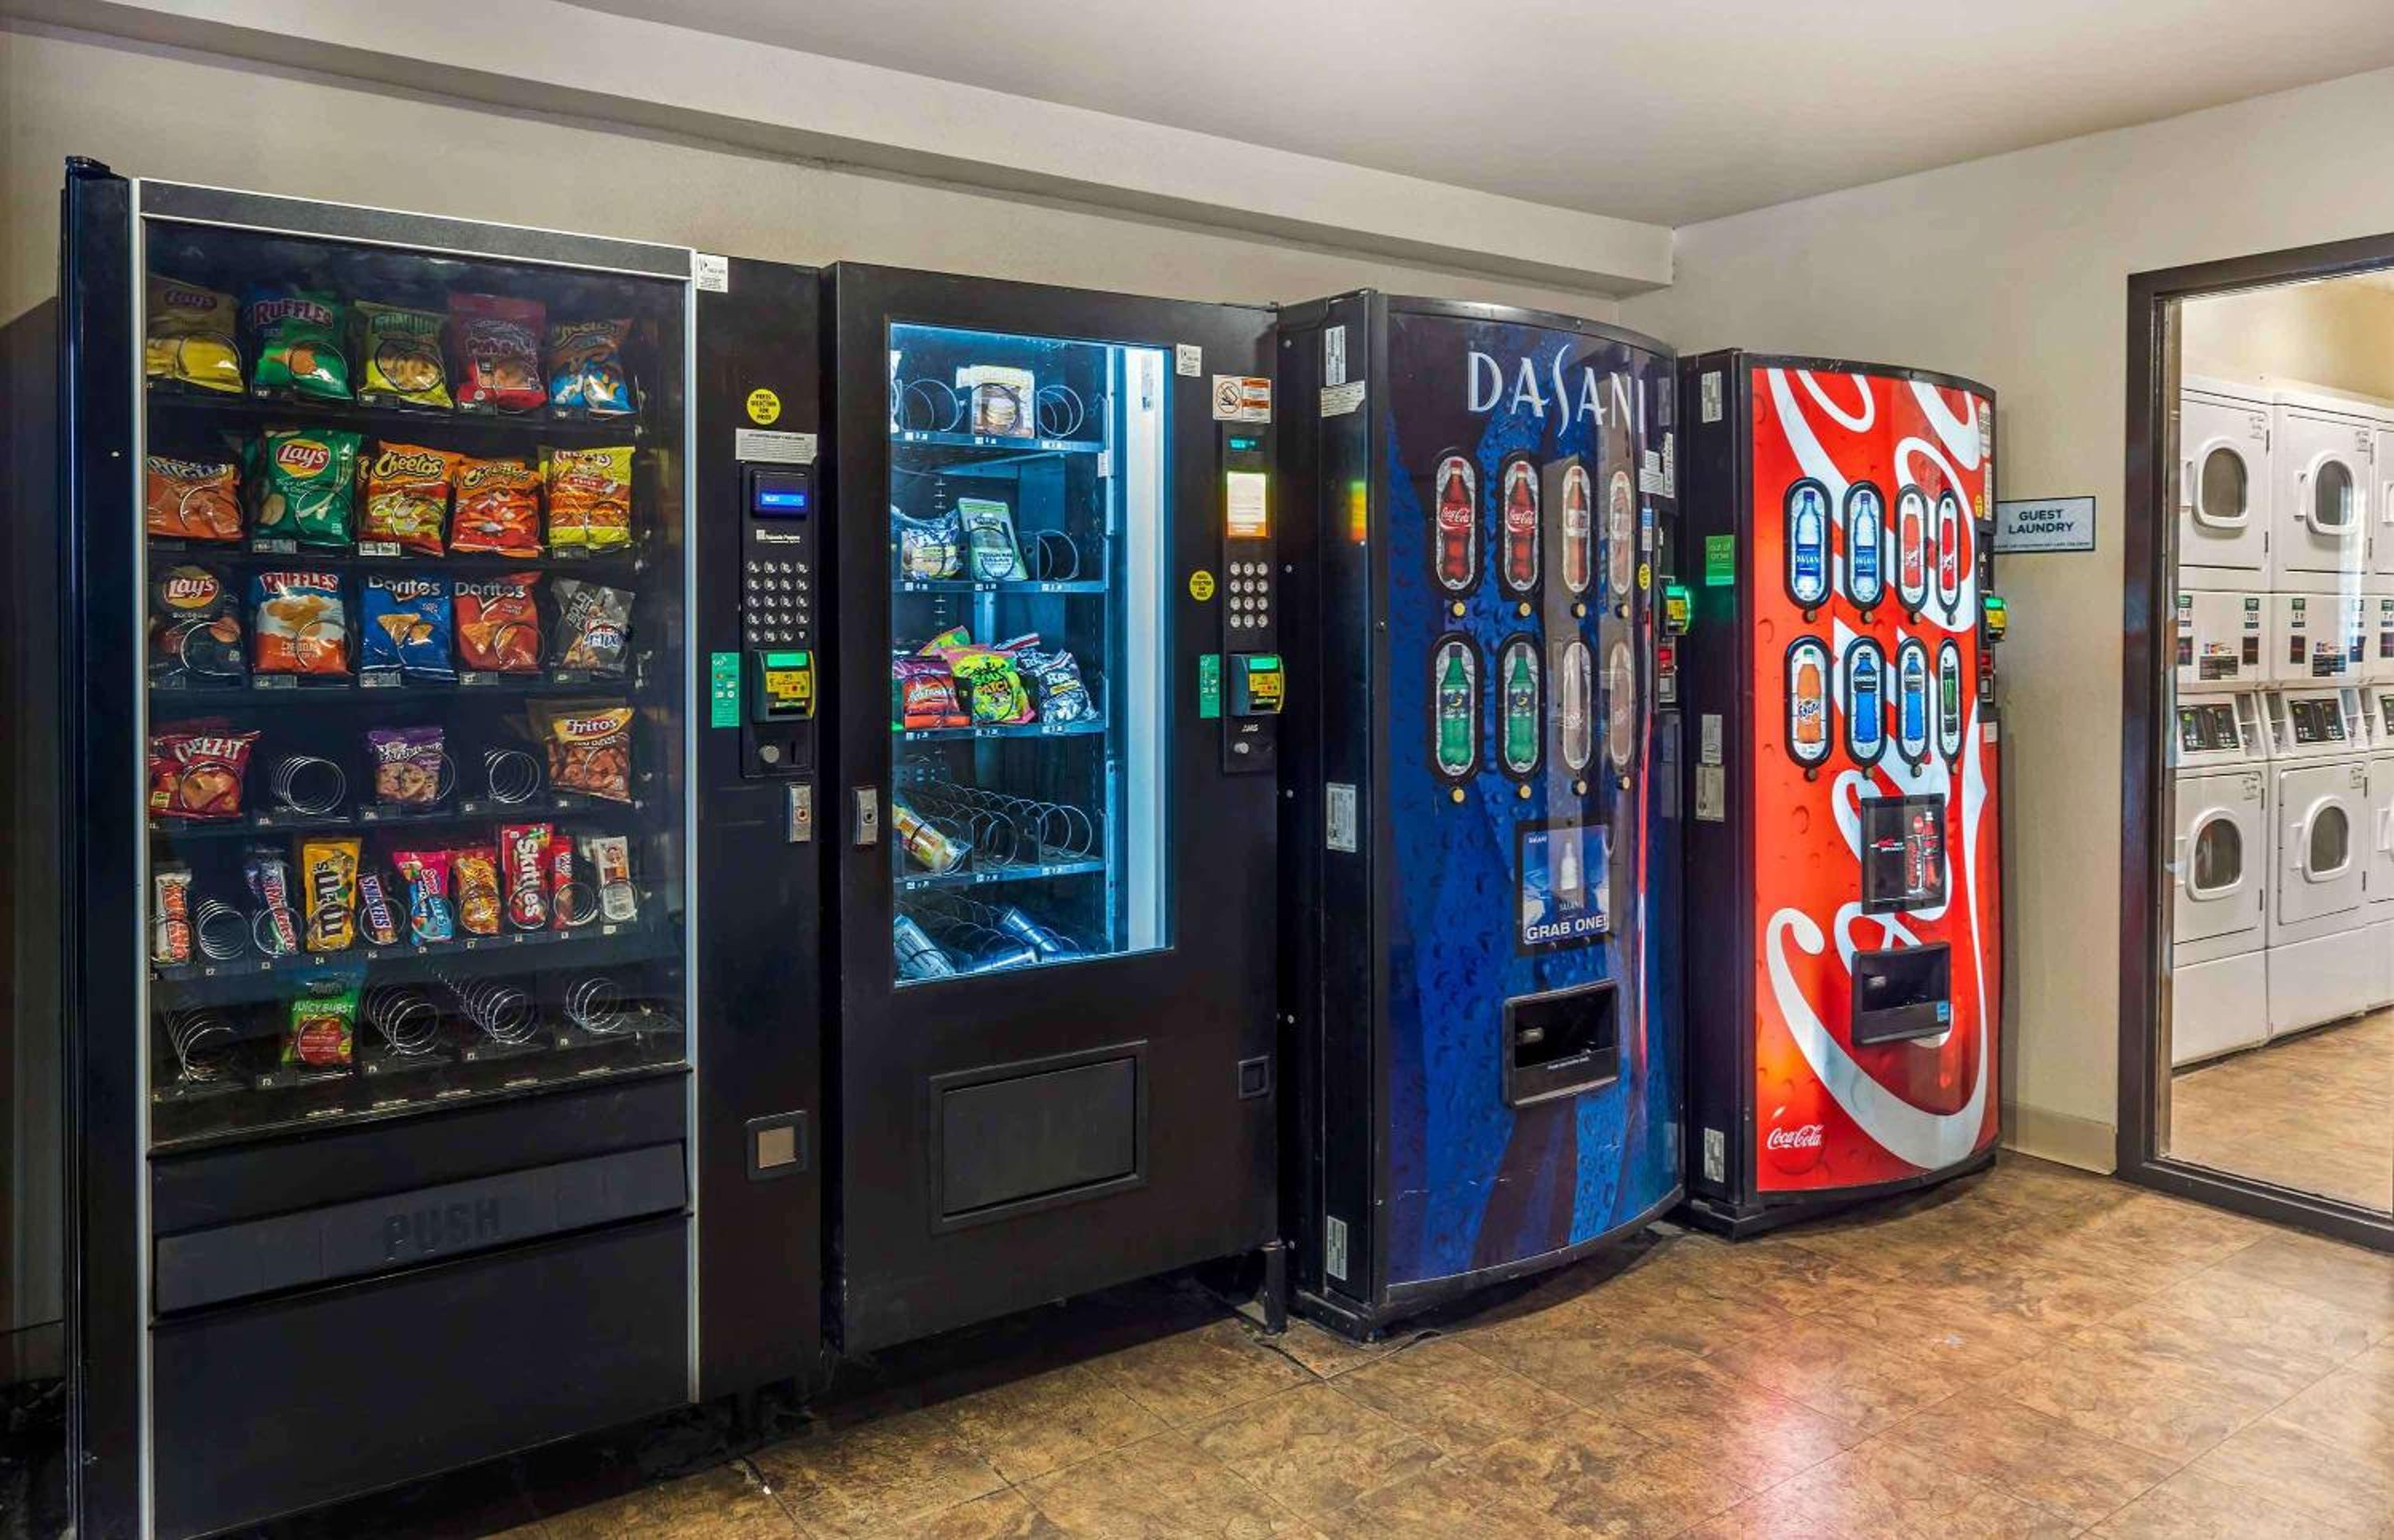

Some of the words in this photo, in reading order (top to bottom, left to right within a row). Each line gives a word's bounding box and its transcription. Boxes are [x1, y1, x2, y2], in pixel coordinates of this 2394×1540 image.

[1468, 344, 1645, 438] DASANI
[373, 451, 444, 478] Cheetos
[2018, 509, 2064, 521] GUEST
[2008, 522, 2074, 534] LAUNDRY
[260, 573, 338, 594] RUFFLES
[368, 575, 440, 597] Doritos
[454, 582, 525, 598] Doritos
[566, 718, 618, 734] Fritos
[174, 736, 244, 764] CHEEZ-IT
[516, 839, 541, 918] Skittles
[1527, 922, 1570, 940] GRAB
[1767, 1123, 1825, 1150] Coca-Cola
[383, 1198, 500, 1262] PUSH
